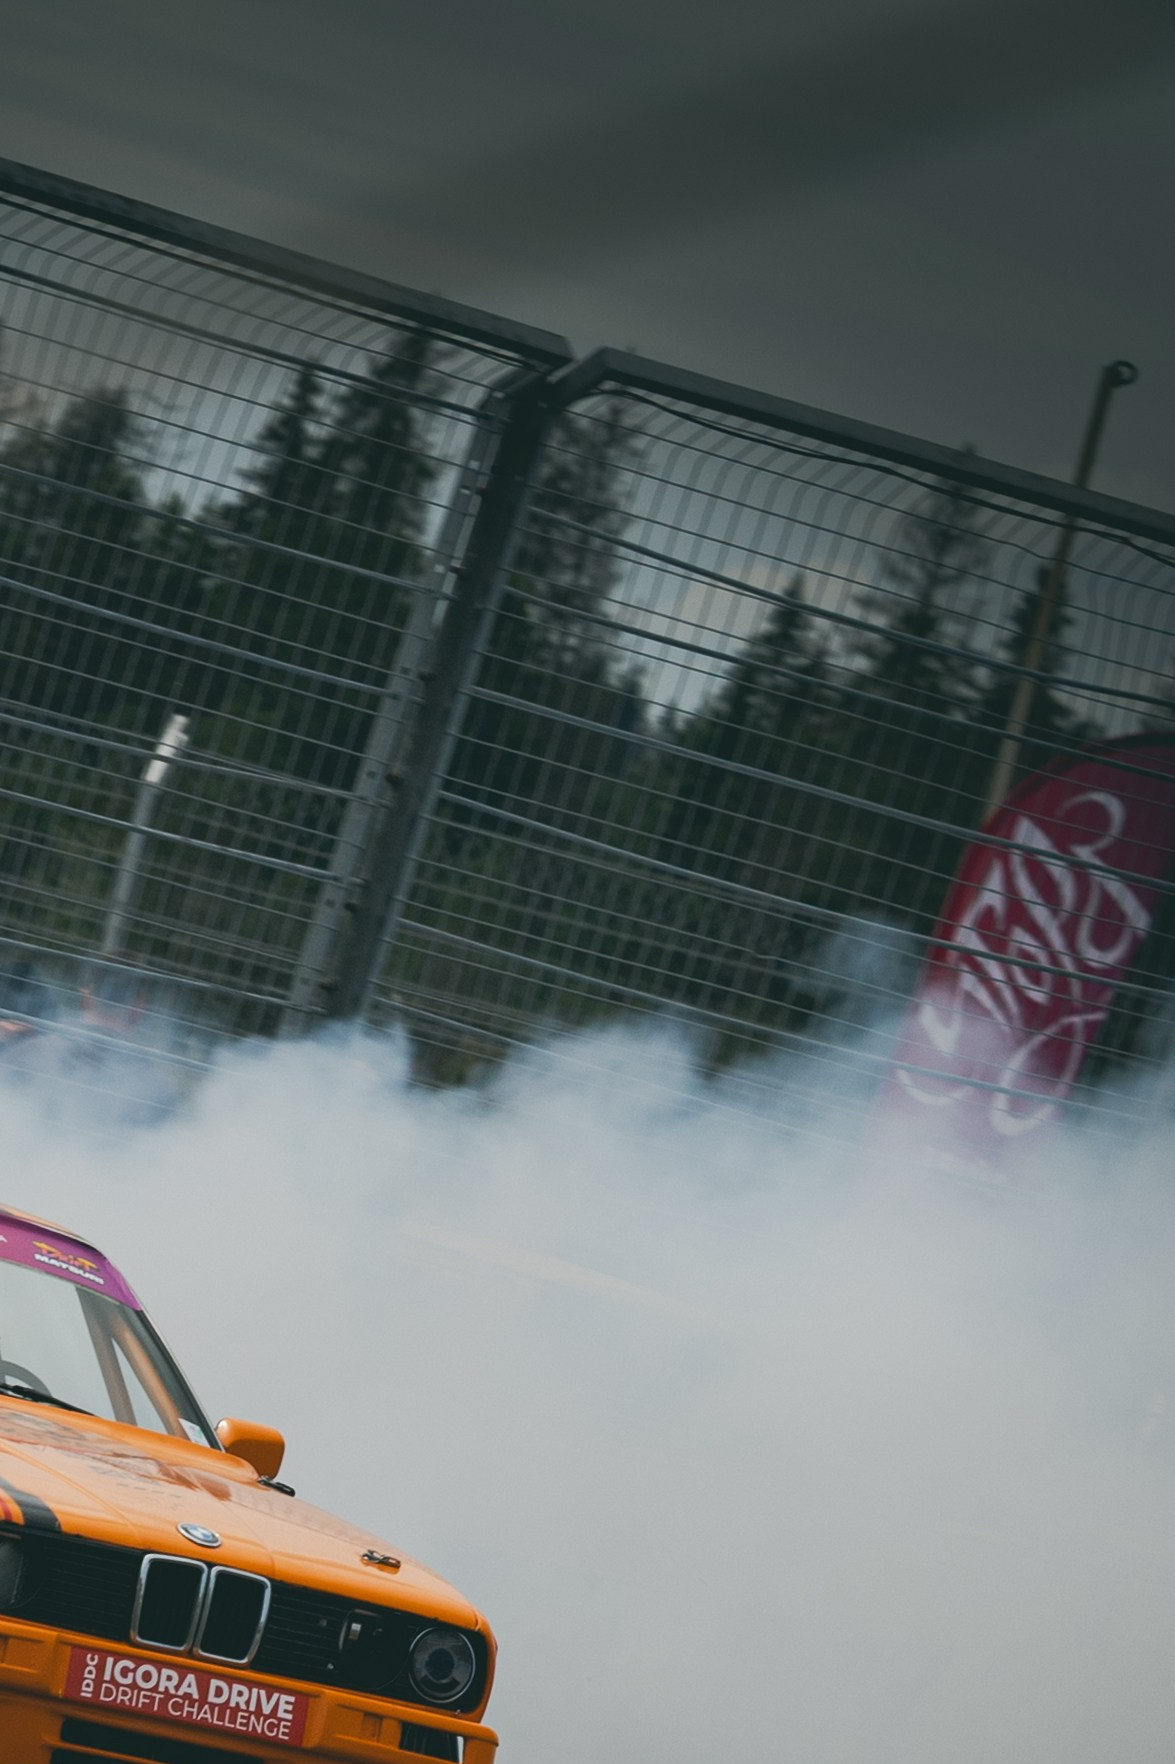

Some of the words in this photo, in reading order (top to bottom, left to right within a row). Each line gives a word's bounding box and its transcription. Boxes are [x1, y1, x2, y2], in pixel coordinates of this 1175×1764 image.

[80, 1653, 99, 1698] IDDC
[103, 1657, 199, 1700] IGORA
[207, 1678, 296, 1721] DRIVE
[100, 1683, 164, 1712] DRIFT
[167, 1698, 292, 1741] CHALLENGE
